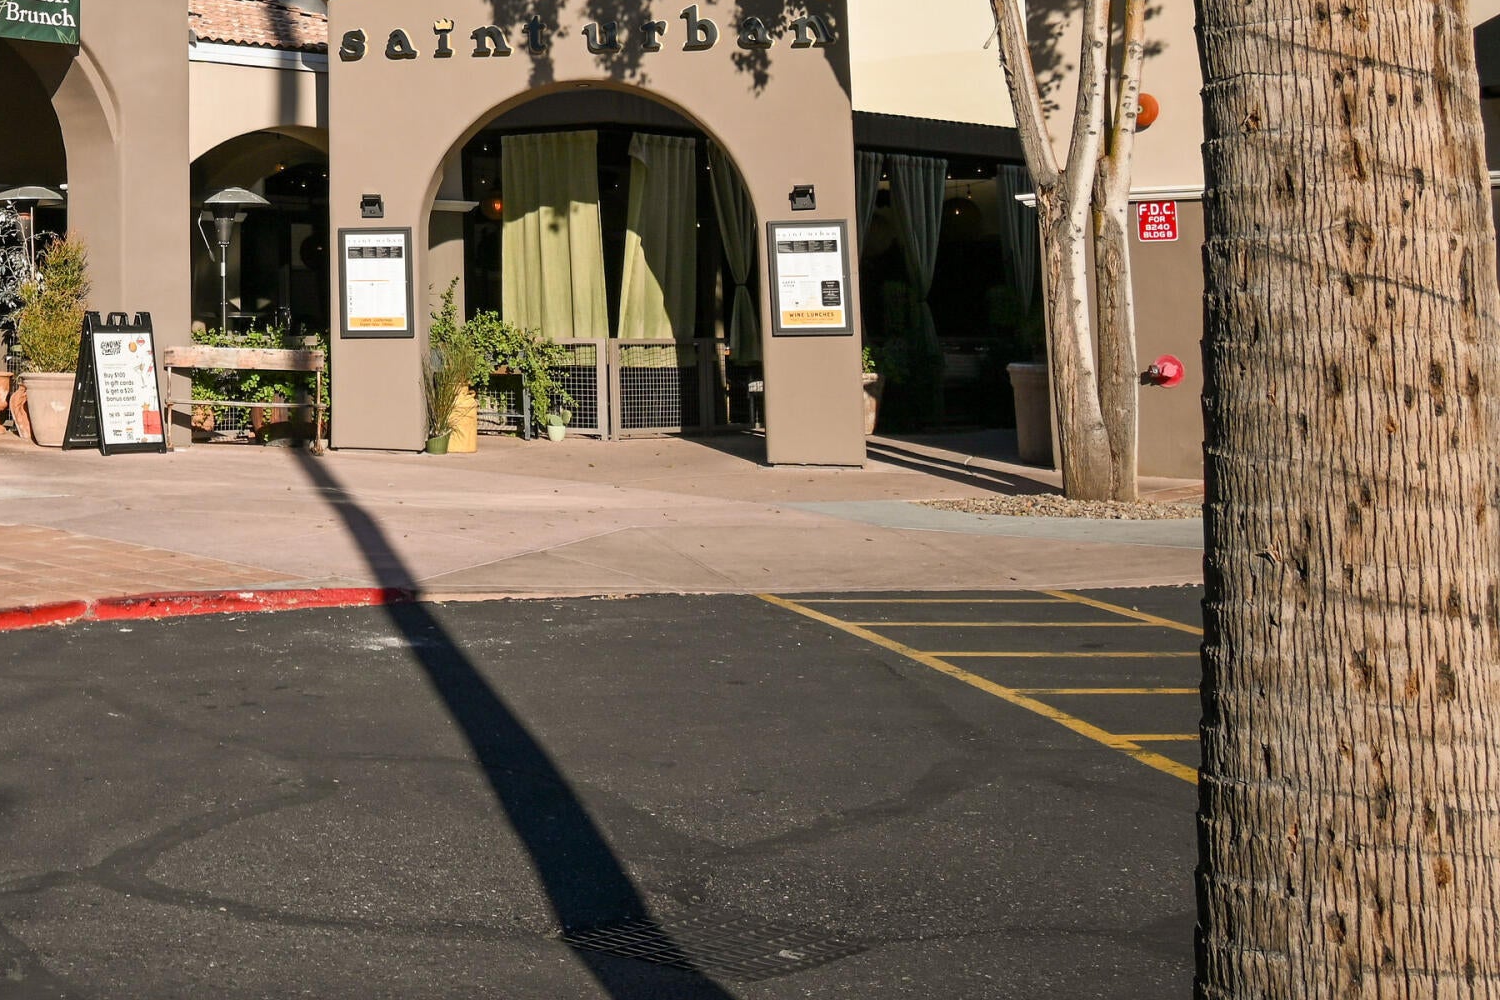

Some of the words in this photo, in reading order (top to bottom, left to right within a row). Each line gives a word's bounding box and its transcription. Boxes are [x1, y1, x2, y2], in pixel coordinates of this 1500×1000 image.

[6, 1, 77, 27] Brunch
[338, 14, 549, 62] saint
[581, 4, 837, 55] urban
[1139, 203, 1174, 215] F.D.C.
